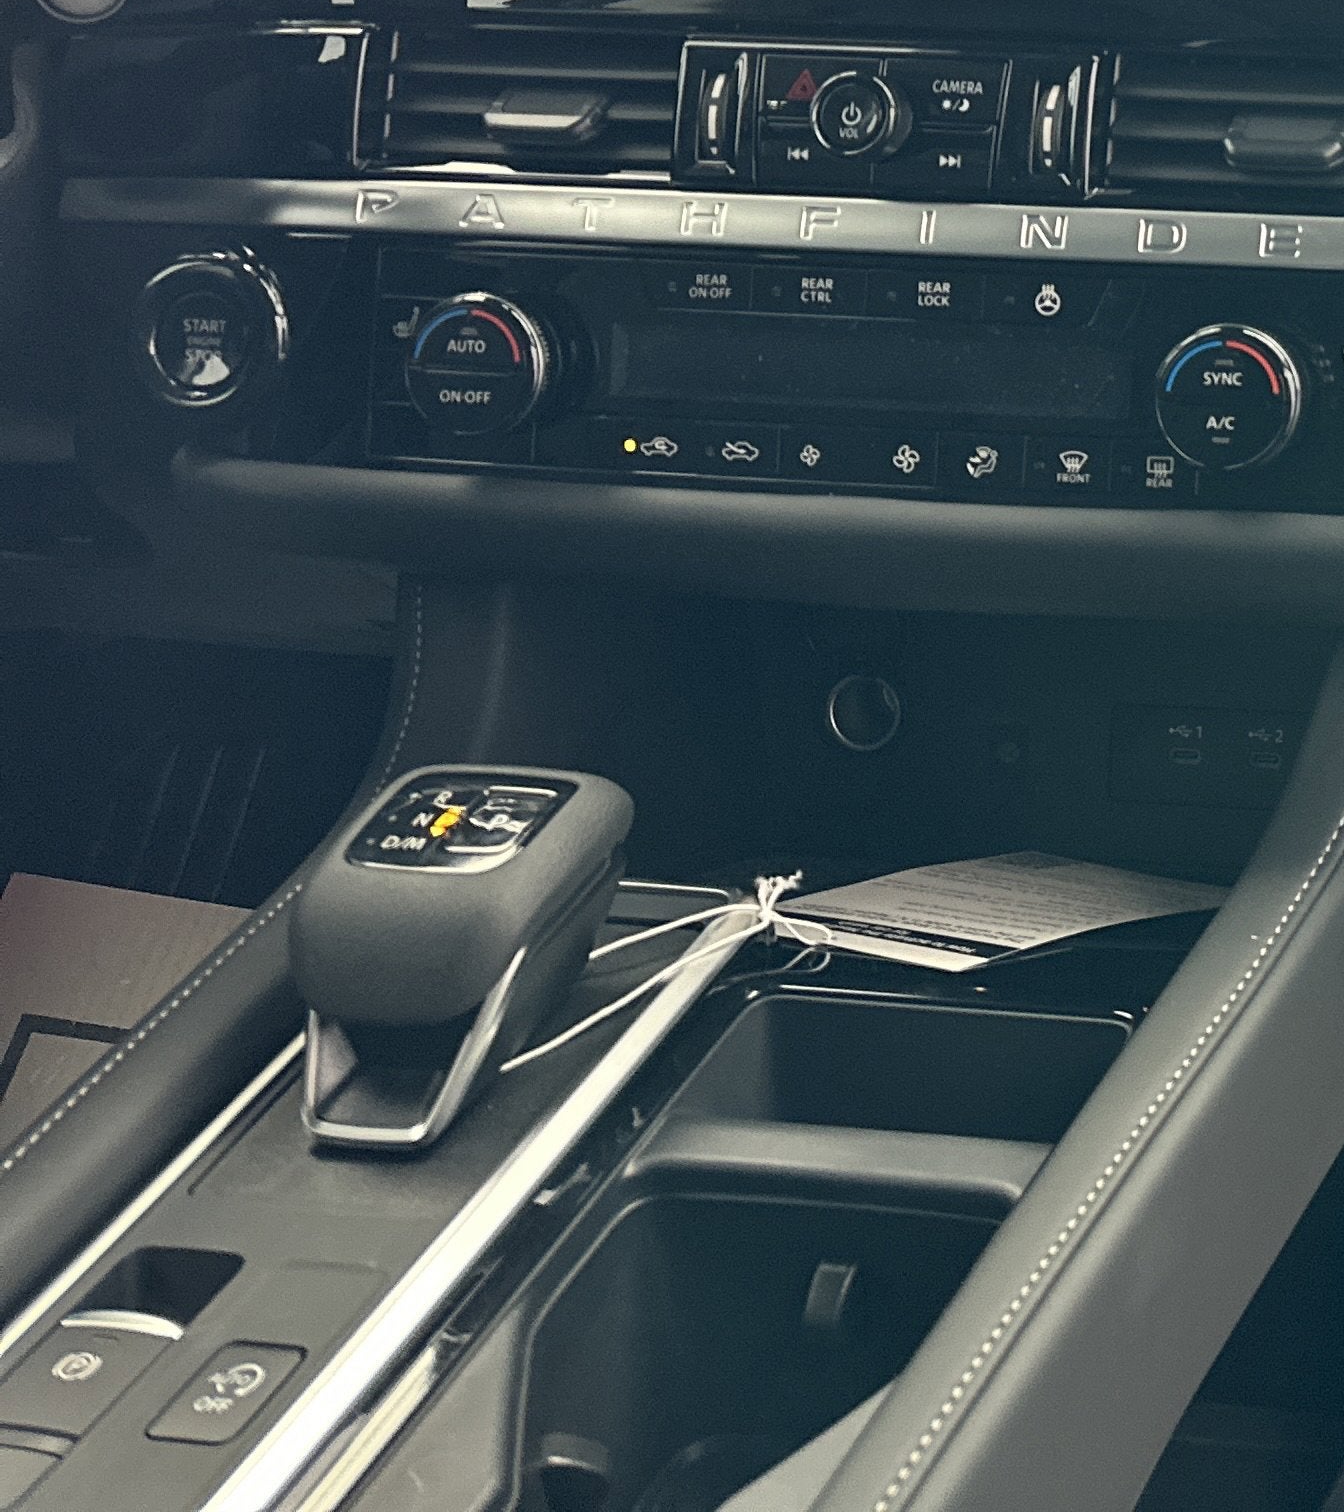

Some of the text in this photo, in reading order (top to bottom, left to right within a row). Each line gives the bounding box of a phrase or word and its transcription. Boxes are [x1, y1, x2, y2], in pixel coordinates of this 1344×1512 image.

[932, 80, 983, 96] CAMERA
[840, 128, 858, 138] VOL
[696, 274, 727, 286] REAR
[801, 278, 833, 290] REAR
[918, 282, 951, 294] REAR
[800, 290, 832, 303] CTRL
[917, 294, 950, 307] LOCK
[183, 318, 226, 333] START
[446, 339, 486, 354] AUTO
[1203, 371, 1243, 387] SYNC
[1206, 416, 1236, 431] A/C
[1056, 473, 1090, 484] FRONT
[411, 812, 434, 827] N
[381, 835, 426, 851] D/M
